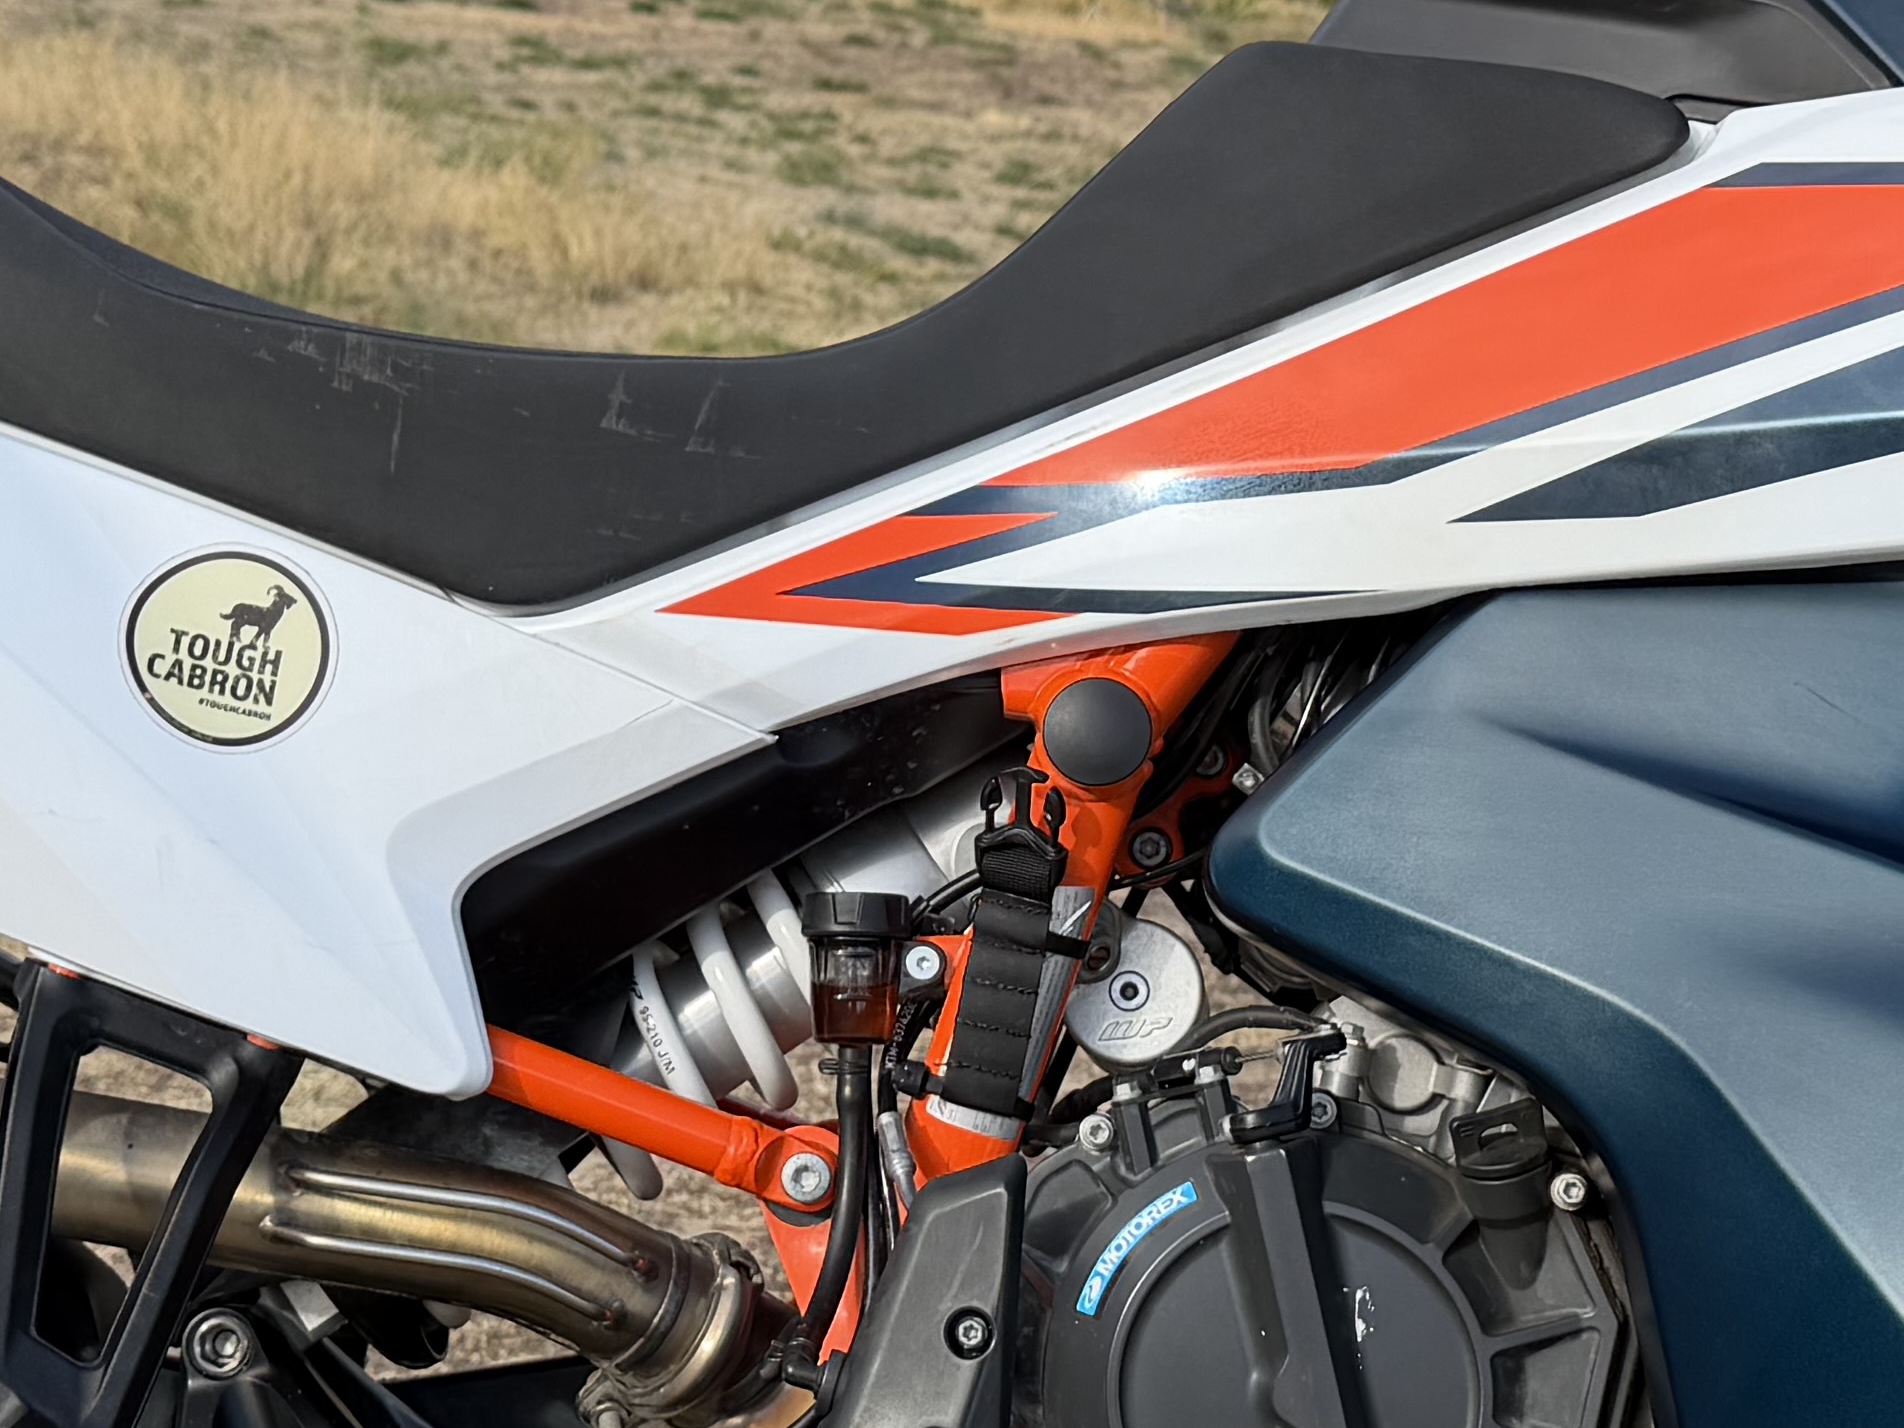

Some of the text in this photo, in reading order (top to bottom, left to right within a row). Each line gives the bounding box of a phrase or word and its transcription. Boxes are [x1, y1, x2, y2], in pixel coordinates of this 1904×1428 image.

[146, 652, 278, 707] CABRON
[169, 627, 284, 678] TOUGH
[1097, 1186, 1189, 1277] MOTOREX
